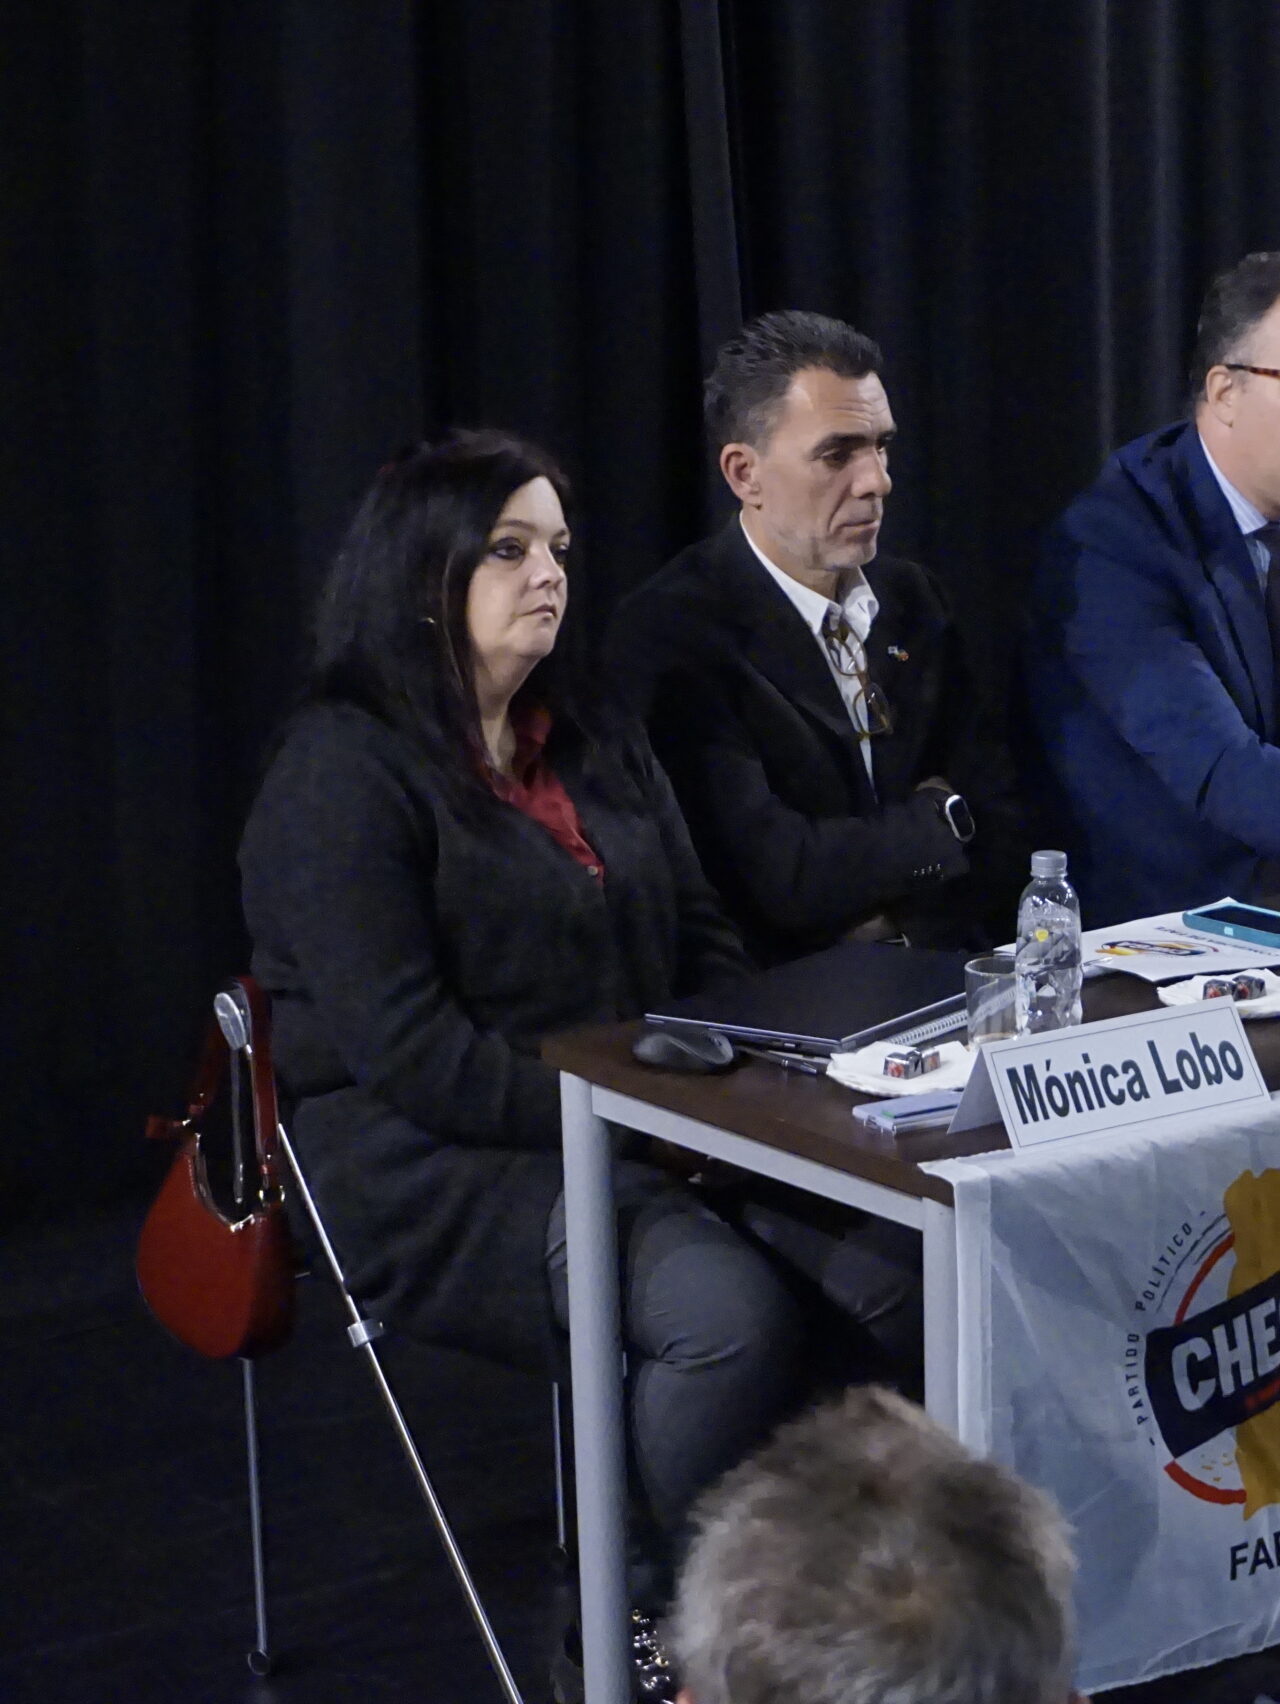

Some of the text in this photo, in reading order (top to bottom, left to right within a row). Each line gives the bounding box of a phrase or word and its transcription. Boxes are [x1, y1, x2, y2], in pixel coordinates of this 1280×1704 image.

[1006, 1031, 1244, 1125] Mónica Lobo
[1125, 1332, 1148, 1426] PARTIDO
